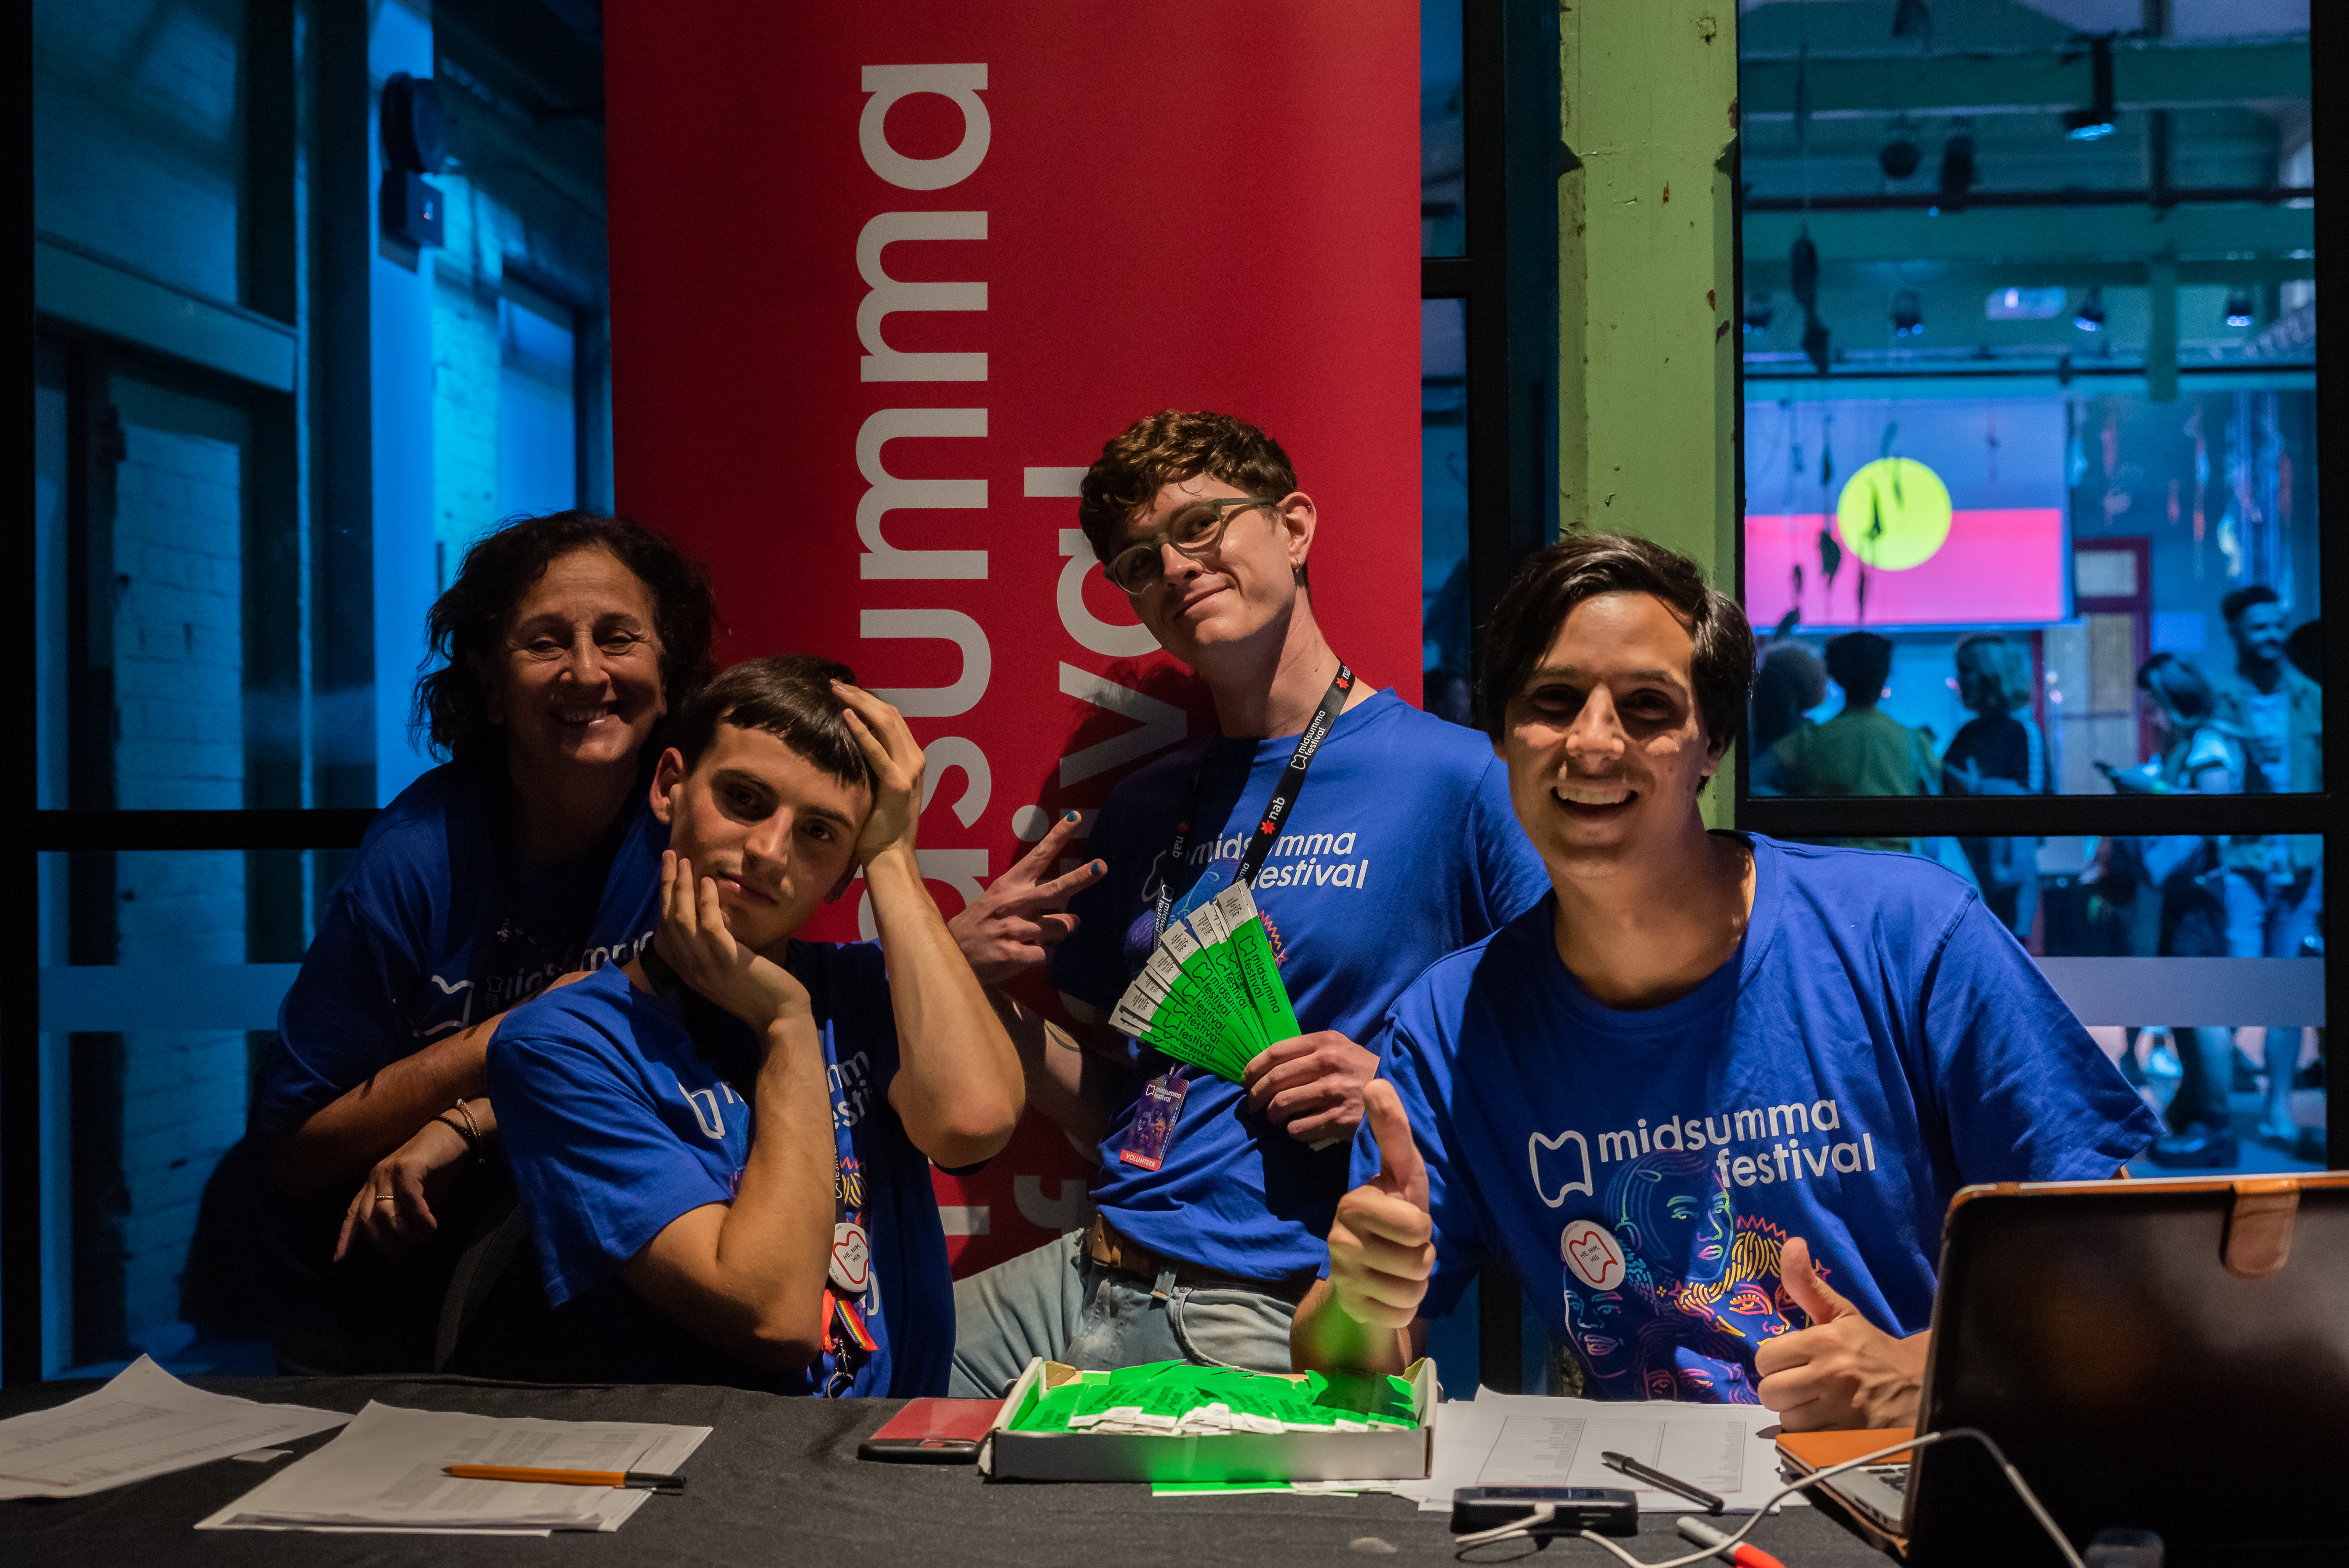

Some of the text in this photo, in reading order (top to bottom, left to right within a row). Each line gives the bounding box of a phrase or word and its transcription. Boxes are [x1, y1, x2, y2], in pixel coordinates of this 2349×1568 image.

[1298, 710, 1326, 754] midsumma
[1305, 727, 1326, 756] festival
[1268, 797, 1285, 820] nab
[1172, 835, 1185, 858] nab
[1189, 832, 1357, 865] midsmma
[1155, 899, 1164, 932] festival
[1243, 958, 1265, 999] festival
[1252, 954, 1280, 1014] midsumma
[1203, 983, 1232, 1017] festival
[1195, 999, 1227, 1032] festival
[1179, 1027, 1215, 1054] festival
[1153, 1093, 1171, 1102] festival
[1156, 1087, 1182, 1099] midsumma
[1598, 1099, 1840, 1163] midsumma
[1126, 1153, 1156, 1167] VOLUNTEER
[1717, 1133, 1876, 1189] festival
[843, 1243, 862, 1260] HE, HIM,
[852, 1253, 861, 1263] HIS
[1588, 1245, 1600, 1254] HIM,
